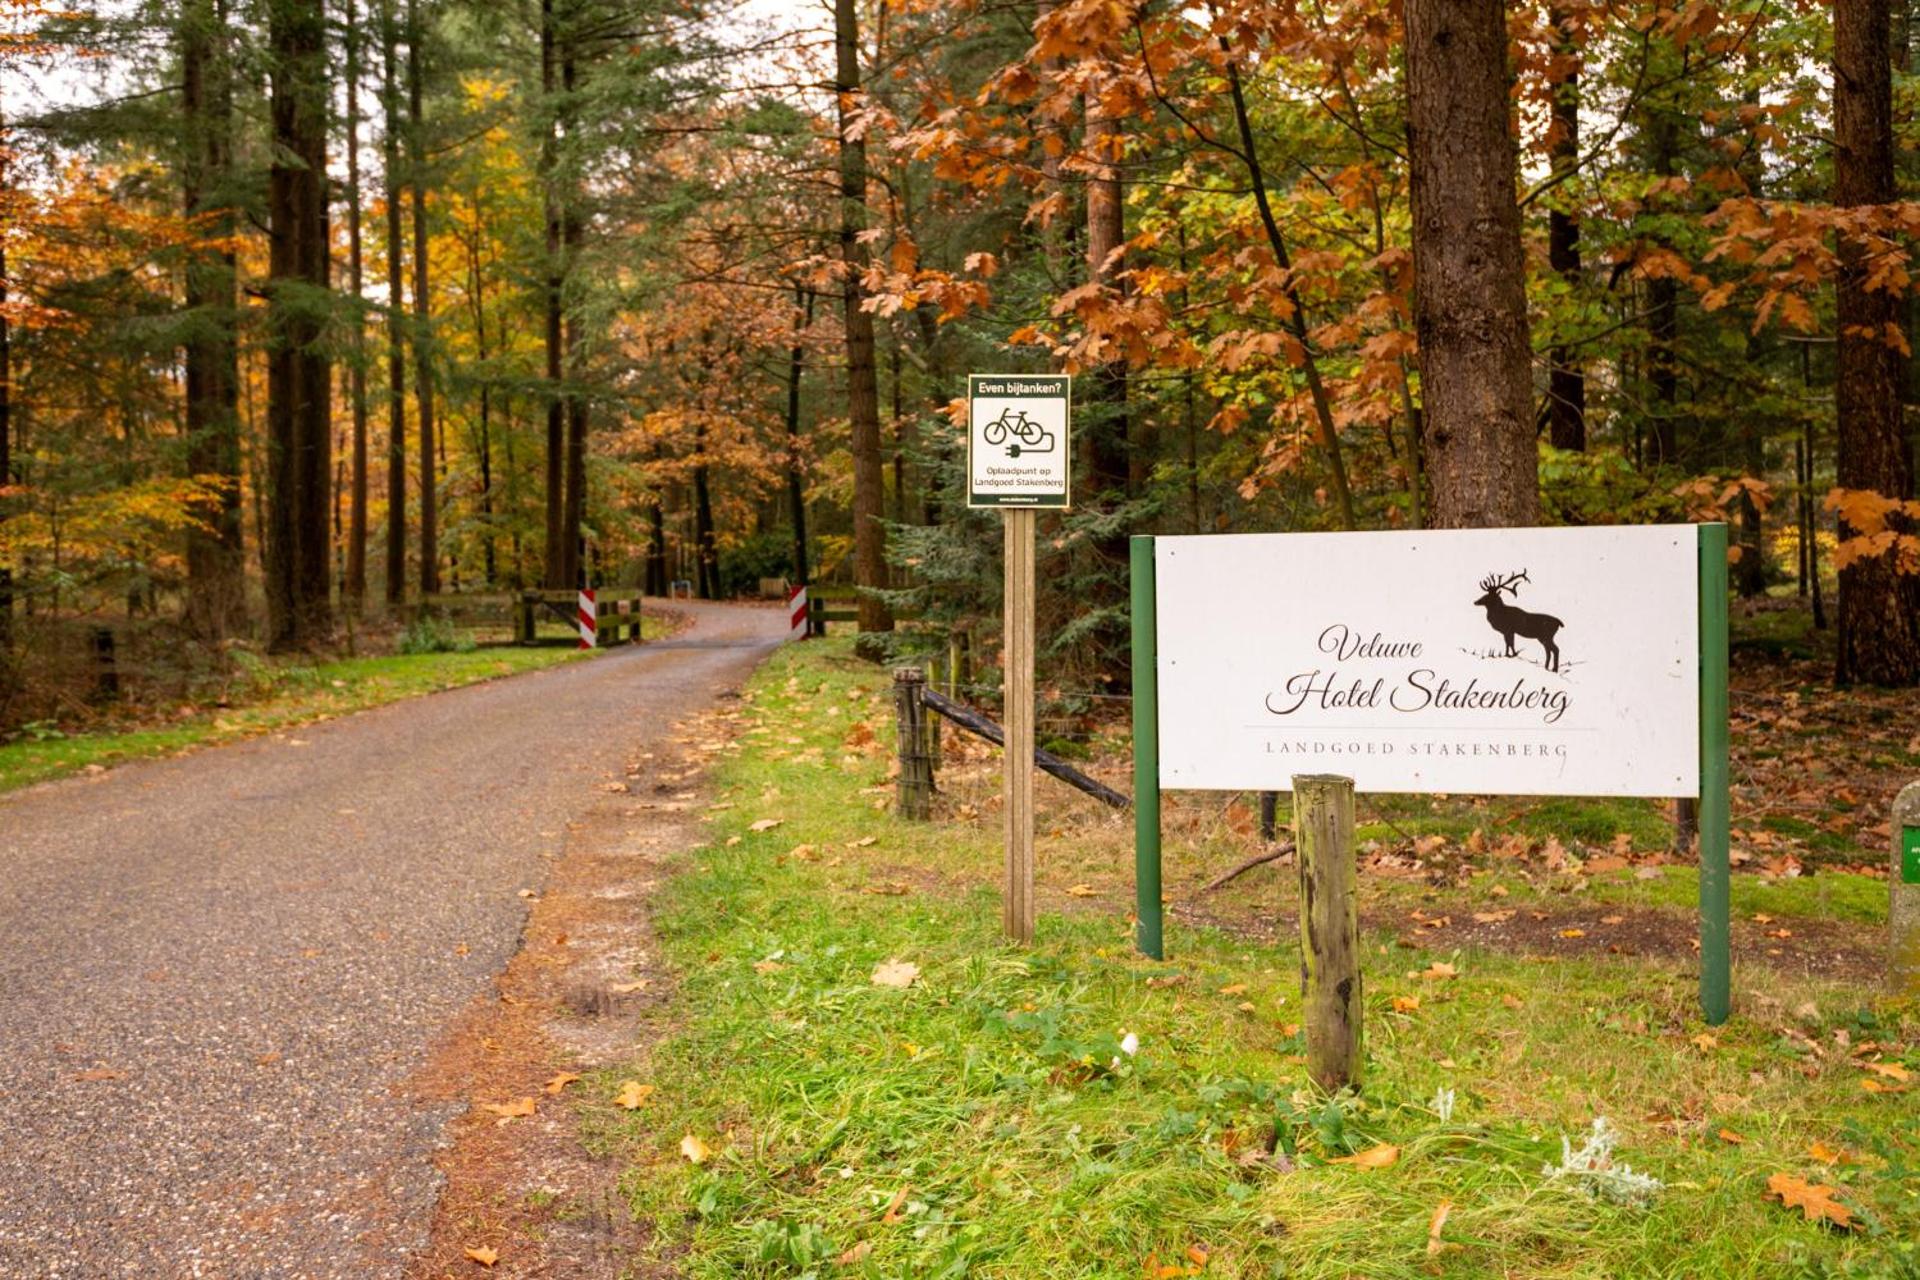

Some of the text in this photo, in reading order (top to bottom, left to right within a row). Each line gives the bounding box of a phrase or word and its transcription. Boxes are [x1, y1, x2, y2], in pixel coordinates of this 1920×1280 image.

[978, 382, 1062, 395] Even bijtanken?
[986, 467, 1051, 476] Oplaadpunt op
[974, 478, 1064, 487] Landgoed Stakenberg
[1317, 624, 1424, 662] Veluwe
[1265, 669, 1572, 724] Hotel Stakenberg
[1266, 741, 1568, 756] LANDGOED STAKENBERG
